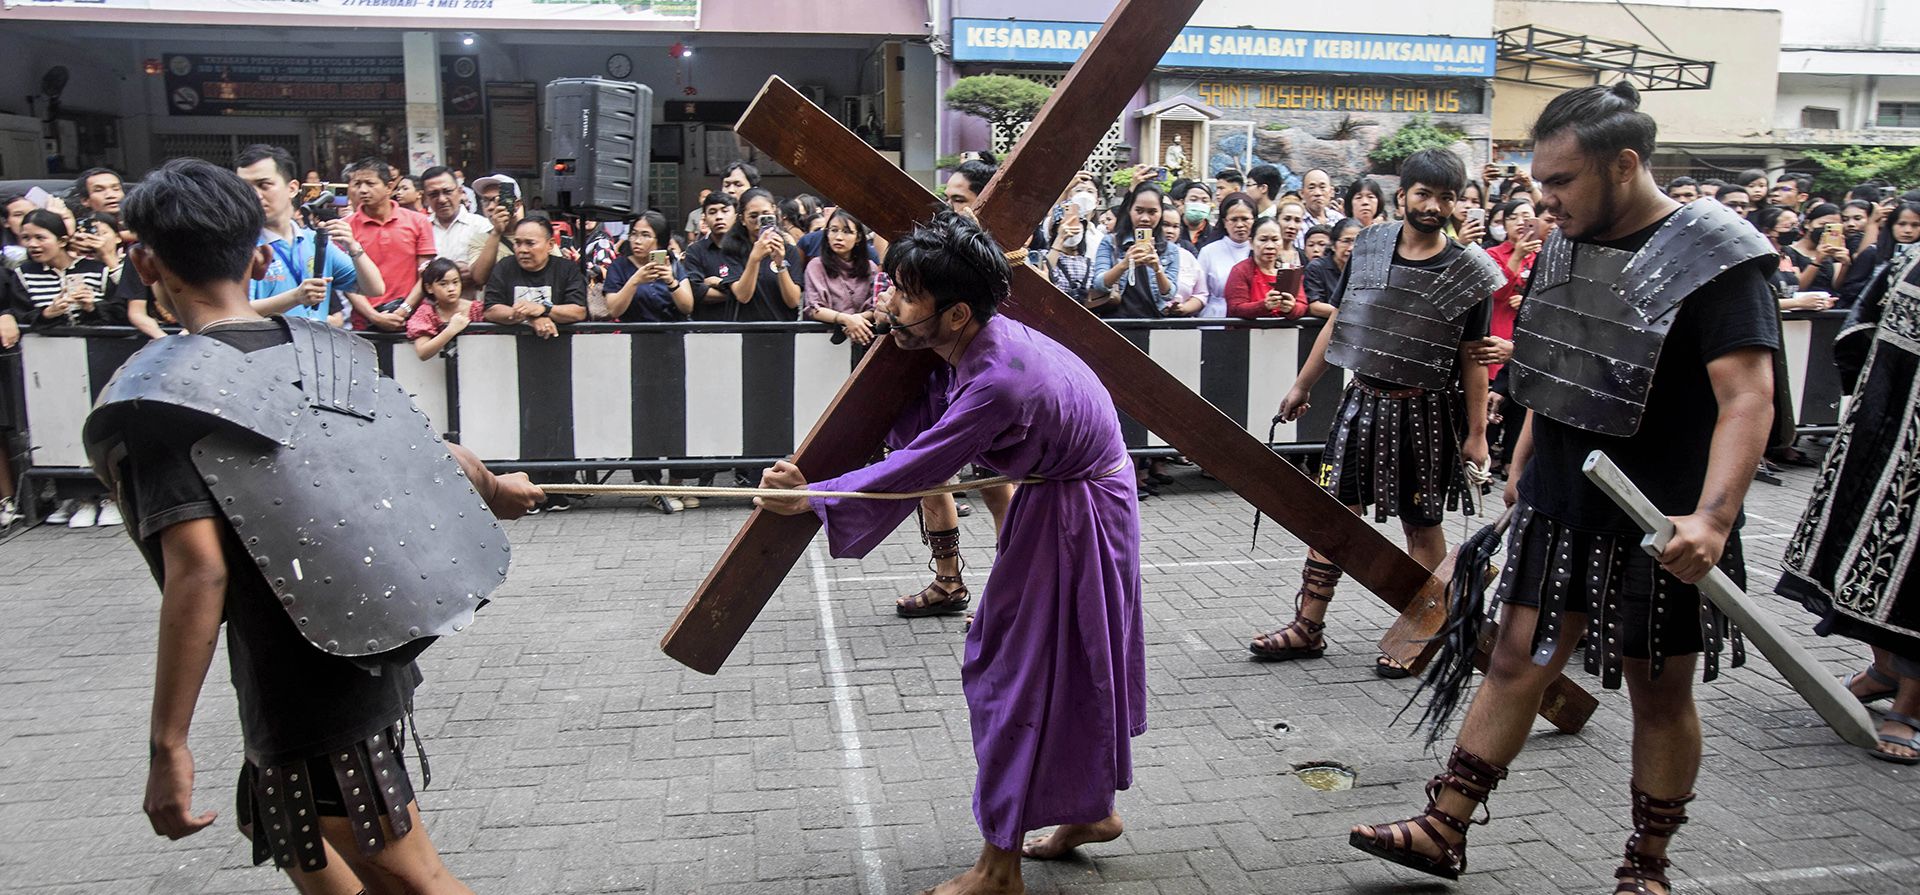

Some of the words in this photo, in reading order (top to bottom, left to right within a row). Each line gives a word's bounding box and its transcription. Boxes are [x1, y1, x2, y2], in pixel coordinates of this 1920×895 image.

[463, 0, 493, 9] 2024
[1209, 35, 1308, 58] SAHABAT
[1314, 38, 1486, 64] KEBIJAKSANAAN
[1199, 82, 1255, 108] SAINT
[1334, 86, 1385, 110] PRAY
[1392, 87, 1428, 111] FOR
[1435, 89, 1459, 112] US
